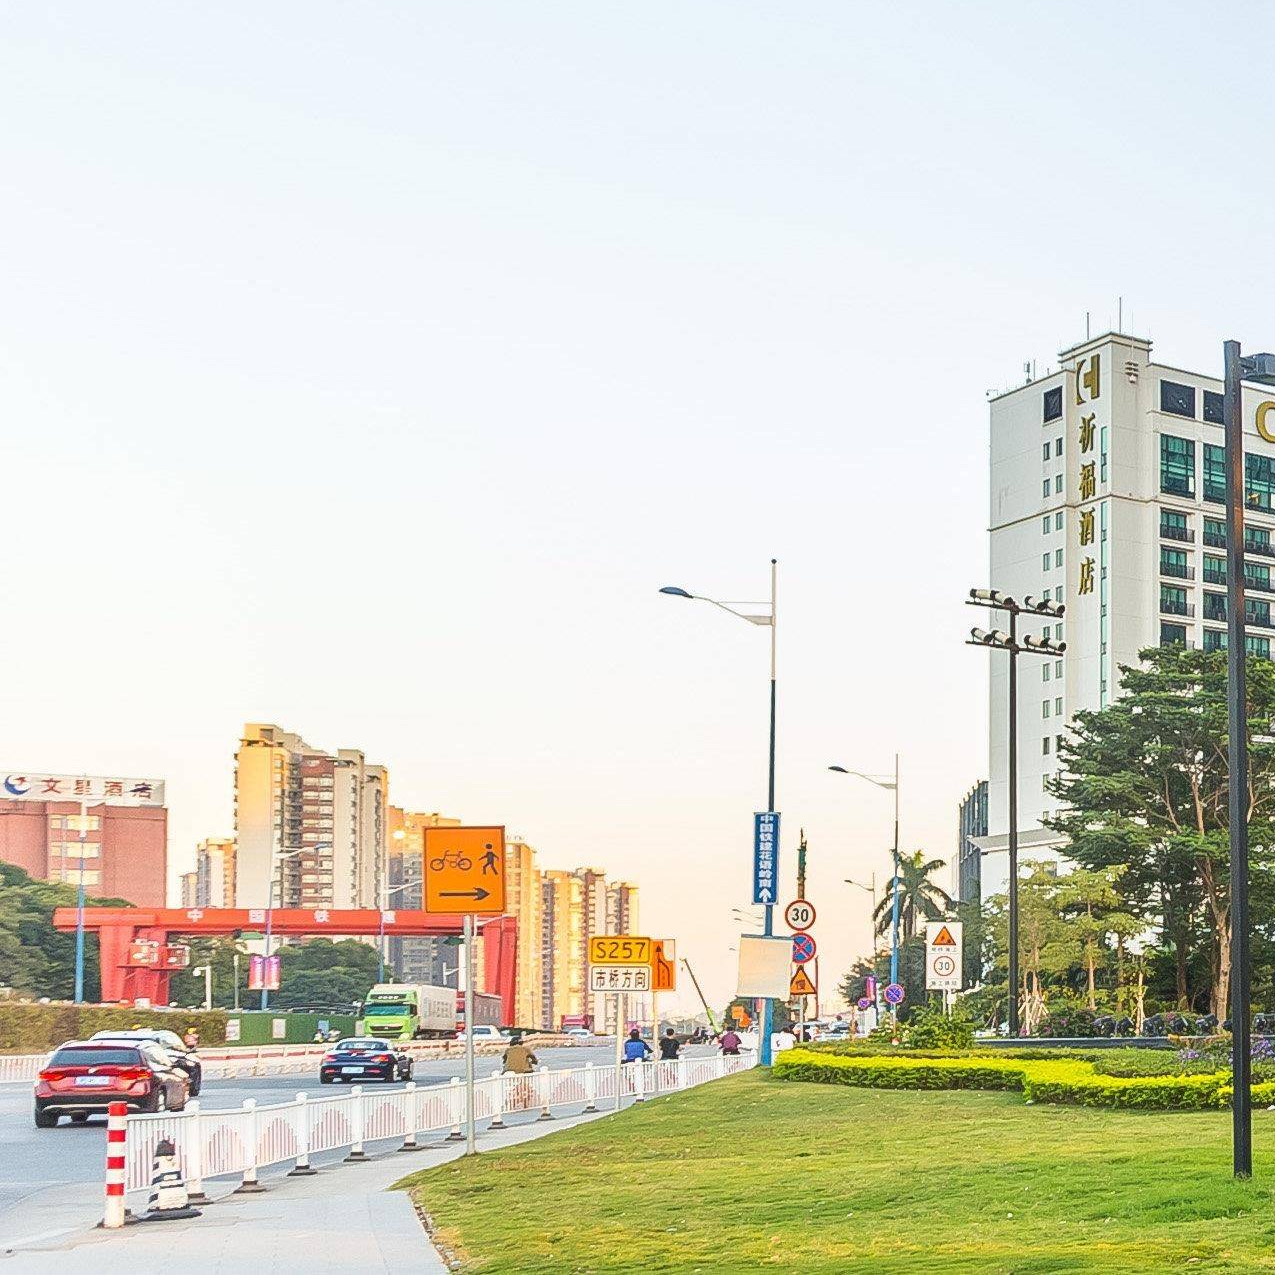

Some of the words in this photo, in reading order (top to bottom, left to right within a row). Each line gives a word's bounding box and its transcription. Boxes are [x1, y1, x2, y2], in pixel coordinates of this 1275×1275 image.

[1078, 411, 1097, 596] 祈福酒店
[791, 907, 809, 923] 30
[596, 941, 646, 959] S257
[937, 961, 950, 971] 30
[595, 968, 646, 988] 市桥方向
